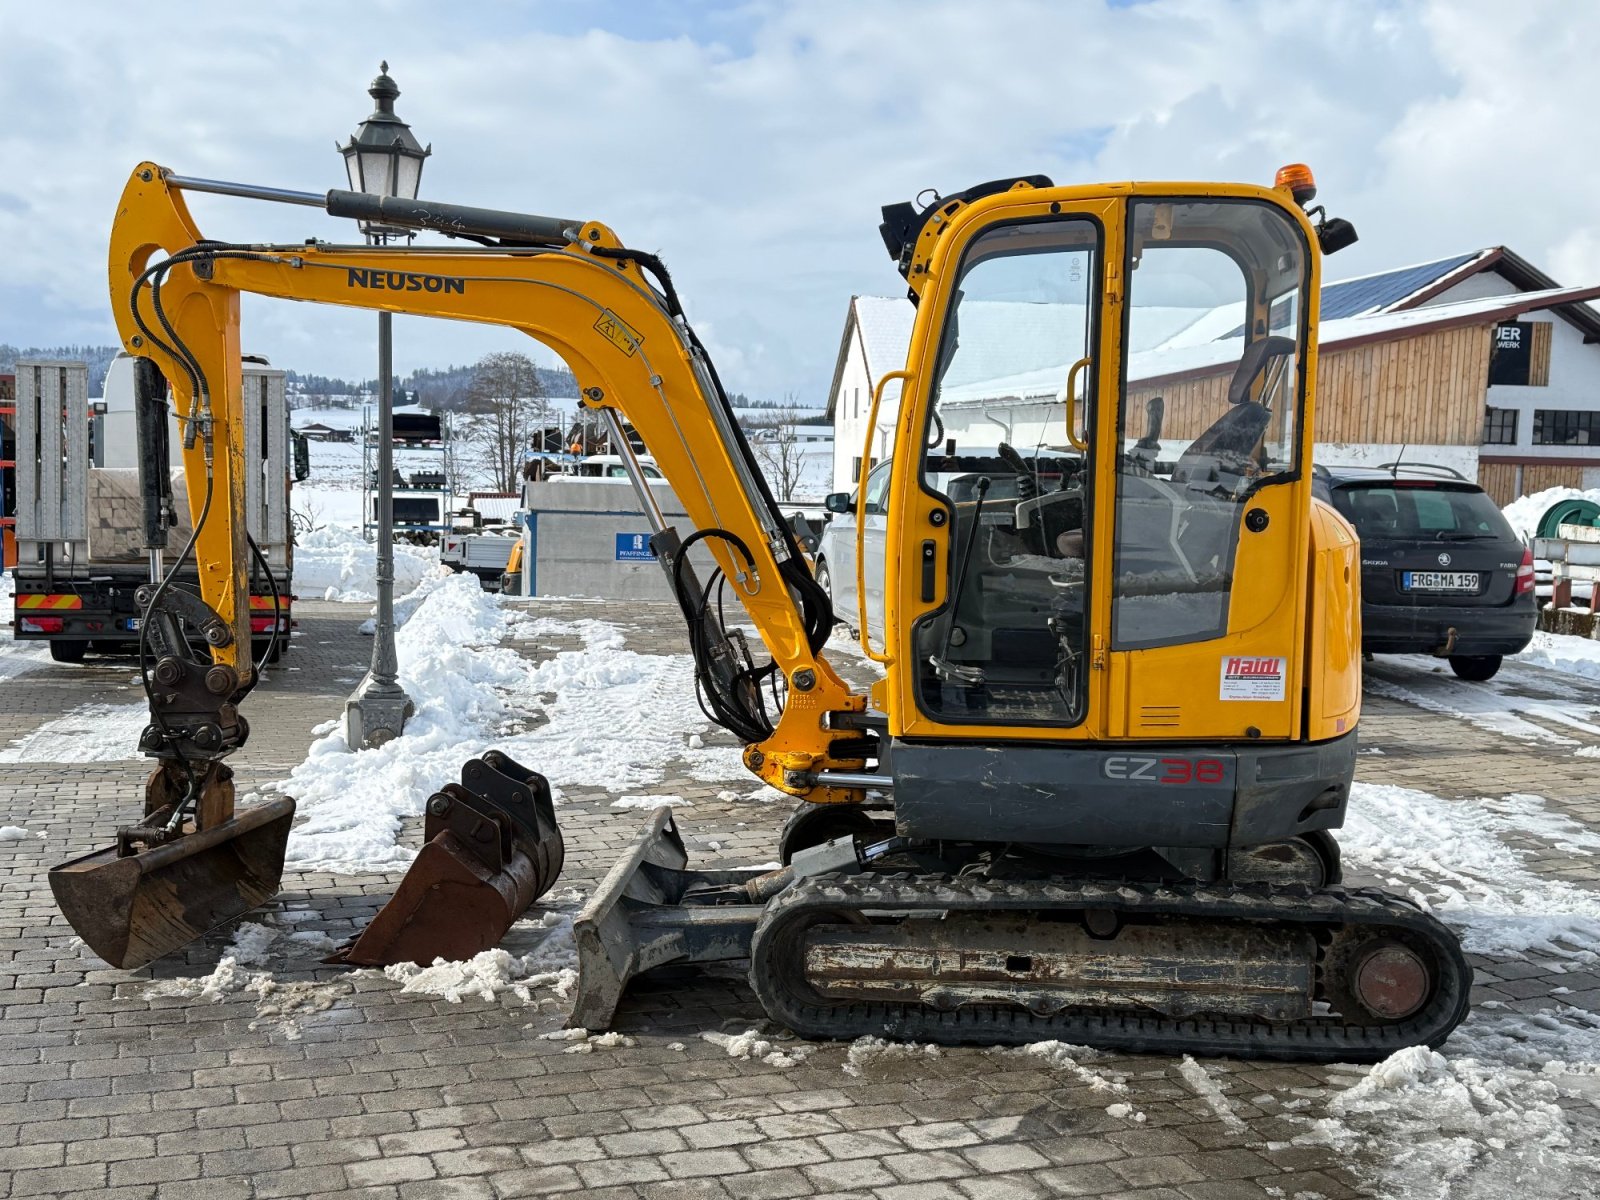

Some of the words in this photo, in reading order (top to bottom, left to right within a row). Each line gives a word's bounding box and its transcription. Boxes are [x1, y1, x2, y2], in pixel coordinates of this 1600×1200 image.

[348, 267, 465, 295] NEUSON
[1411, 573, 1433, 587] FRG
[1440, 574, 1455, 588] MA
[1457, 574, 1479, 588] 159
[1104, 757, 1225, 784] EZ38
